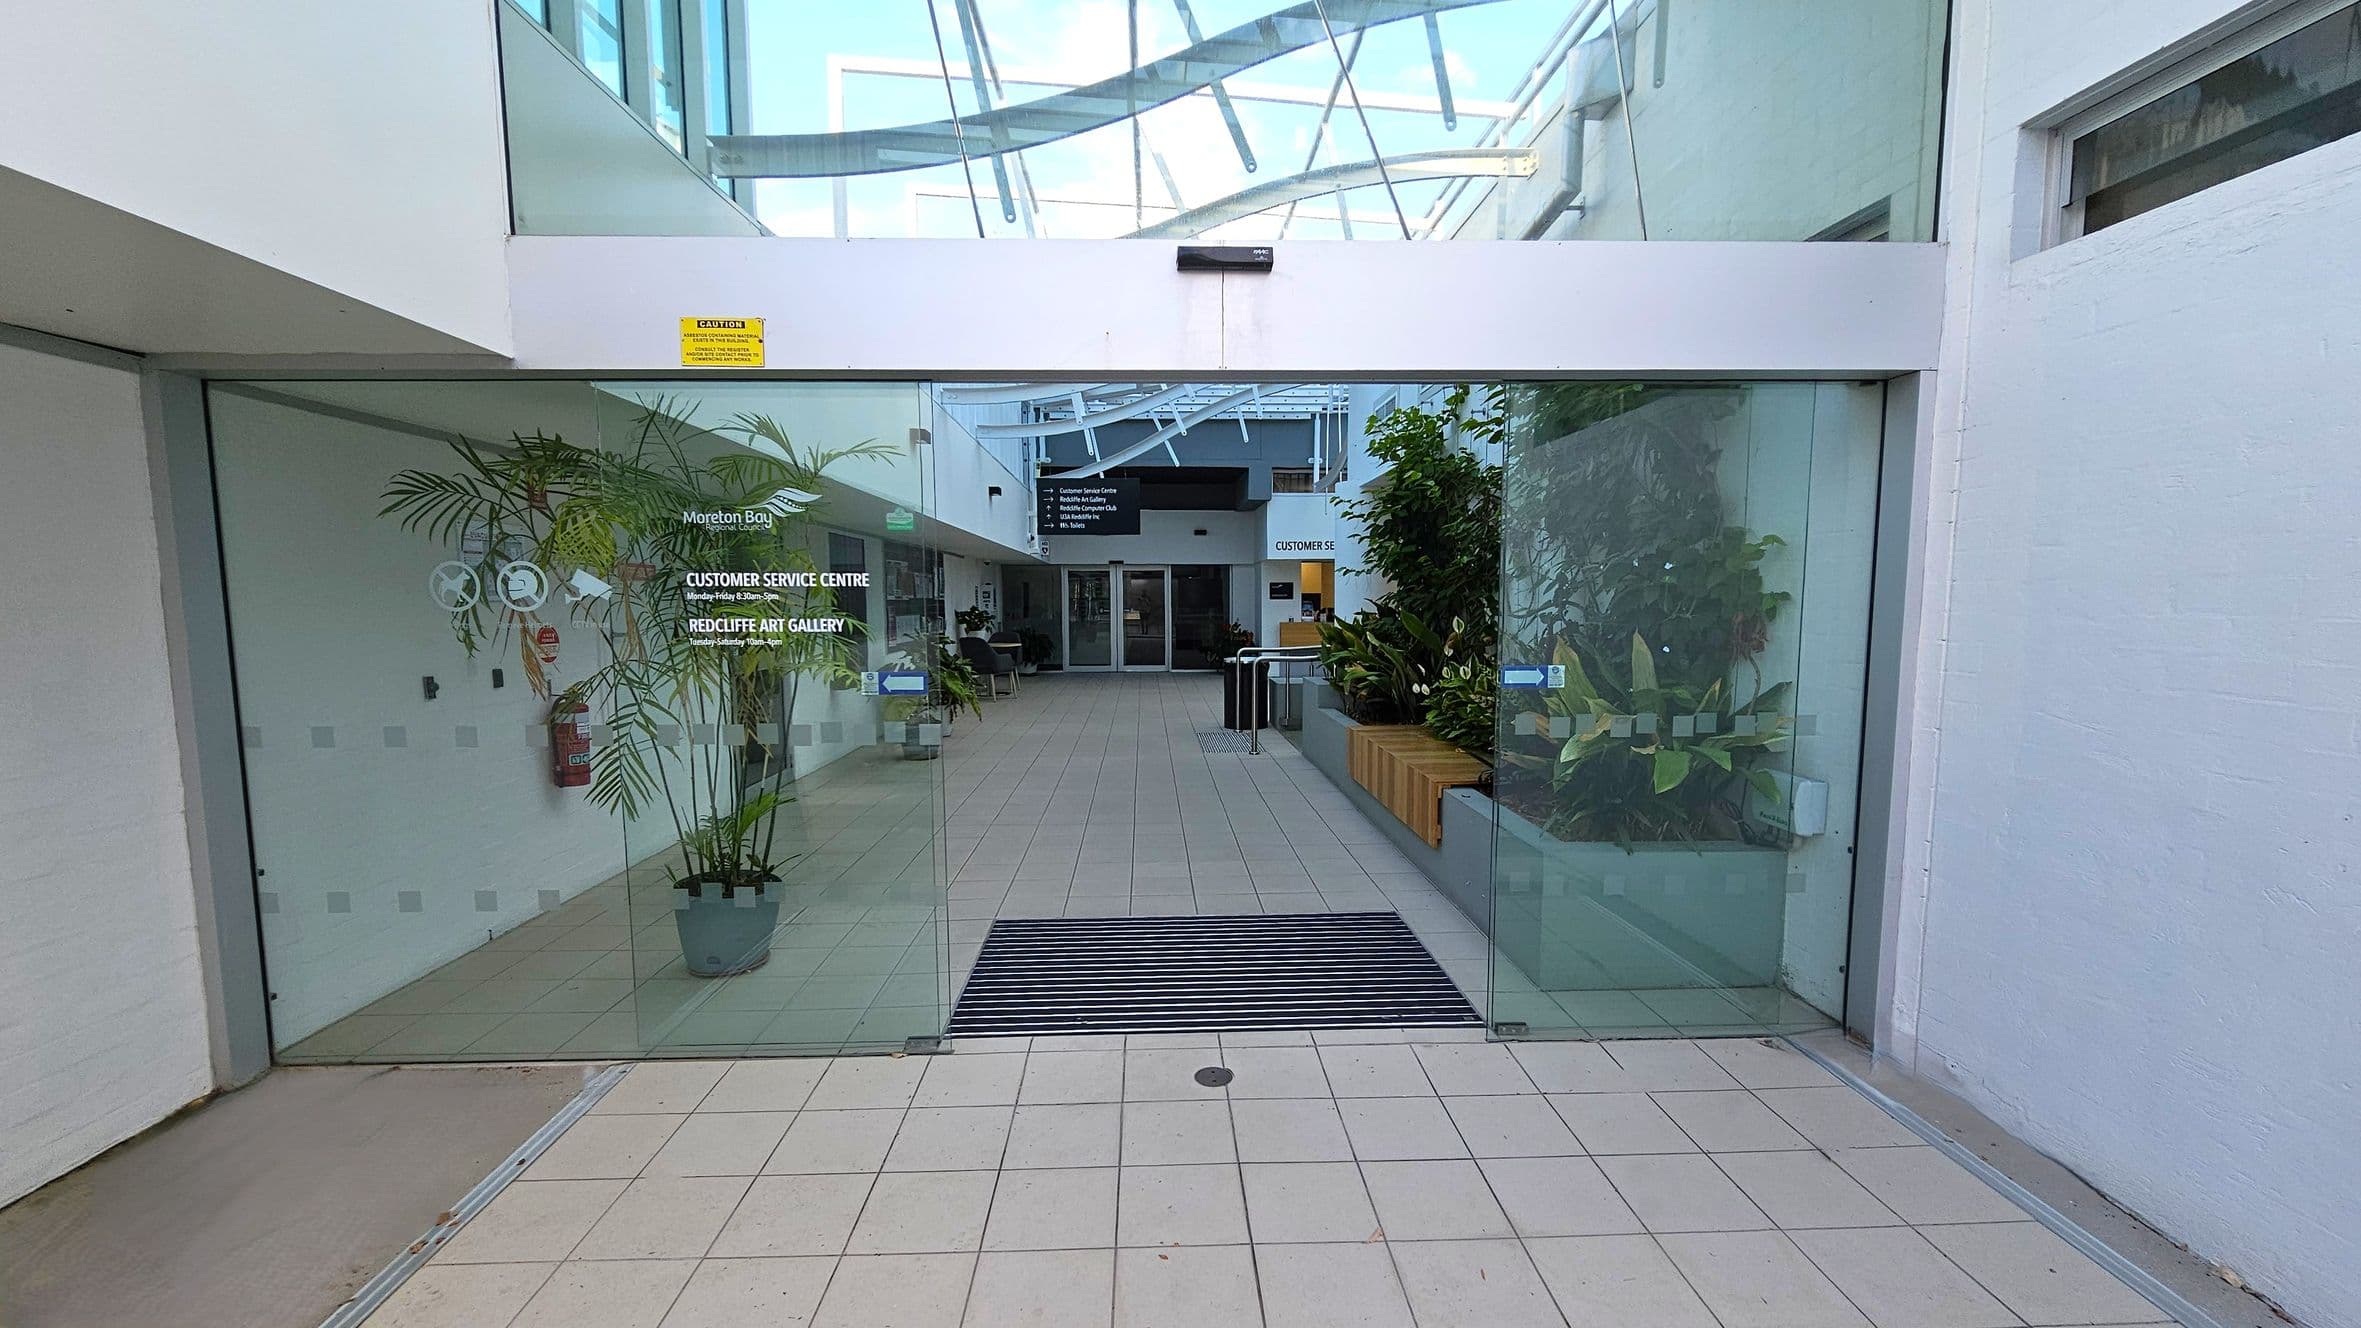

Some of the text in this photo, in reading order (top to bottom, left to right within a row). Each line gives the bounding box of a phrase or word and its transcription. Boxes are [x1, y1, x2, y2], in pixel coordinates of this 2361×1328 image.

[699, 320, 743, 328] CAUTION
[683, 510, 773, 529] Moreton Bay
[705, 523, 766, 532] Regional Council
[1275, 541, 1322, 551] CUSTOMER
[686, 572, 870, 587] CUSTOMER SERVICE CENTRE
[687, 592, 779, 601] Monday-Friday 8:30am-5pm
[689, 618, 845, 633] REDCLIFFE ART GALLERY
[689, 638, 745, 648] Tuesday-Saturday
